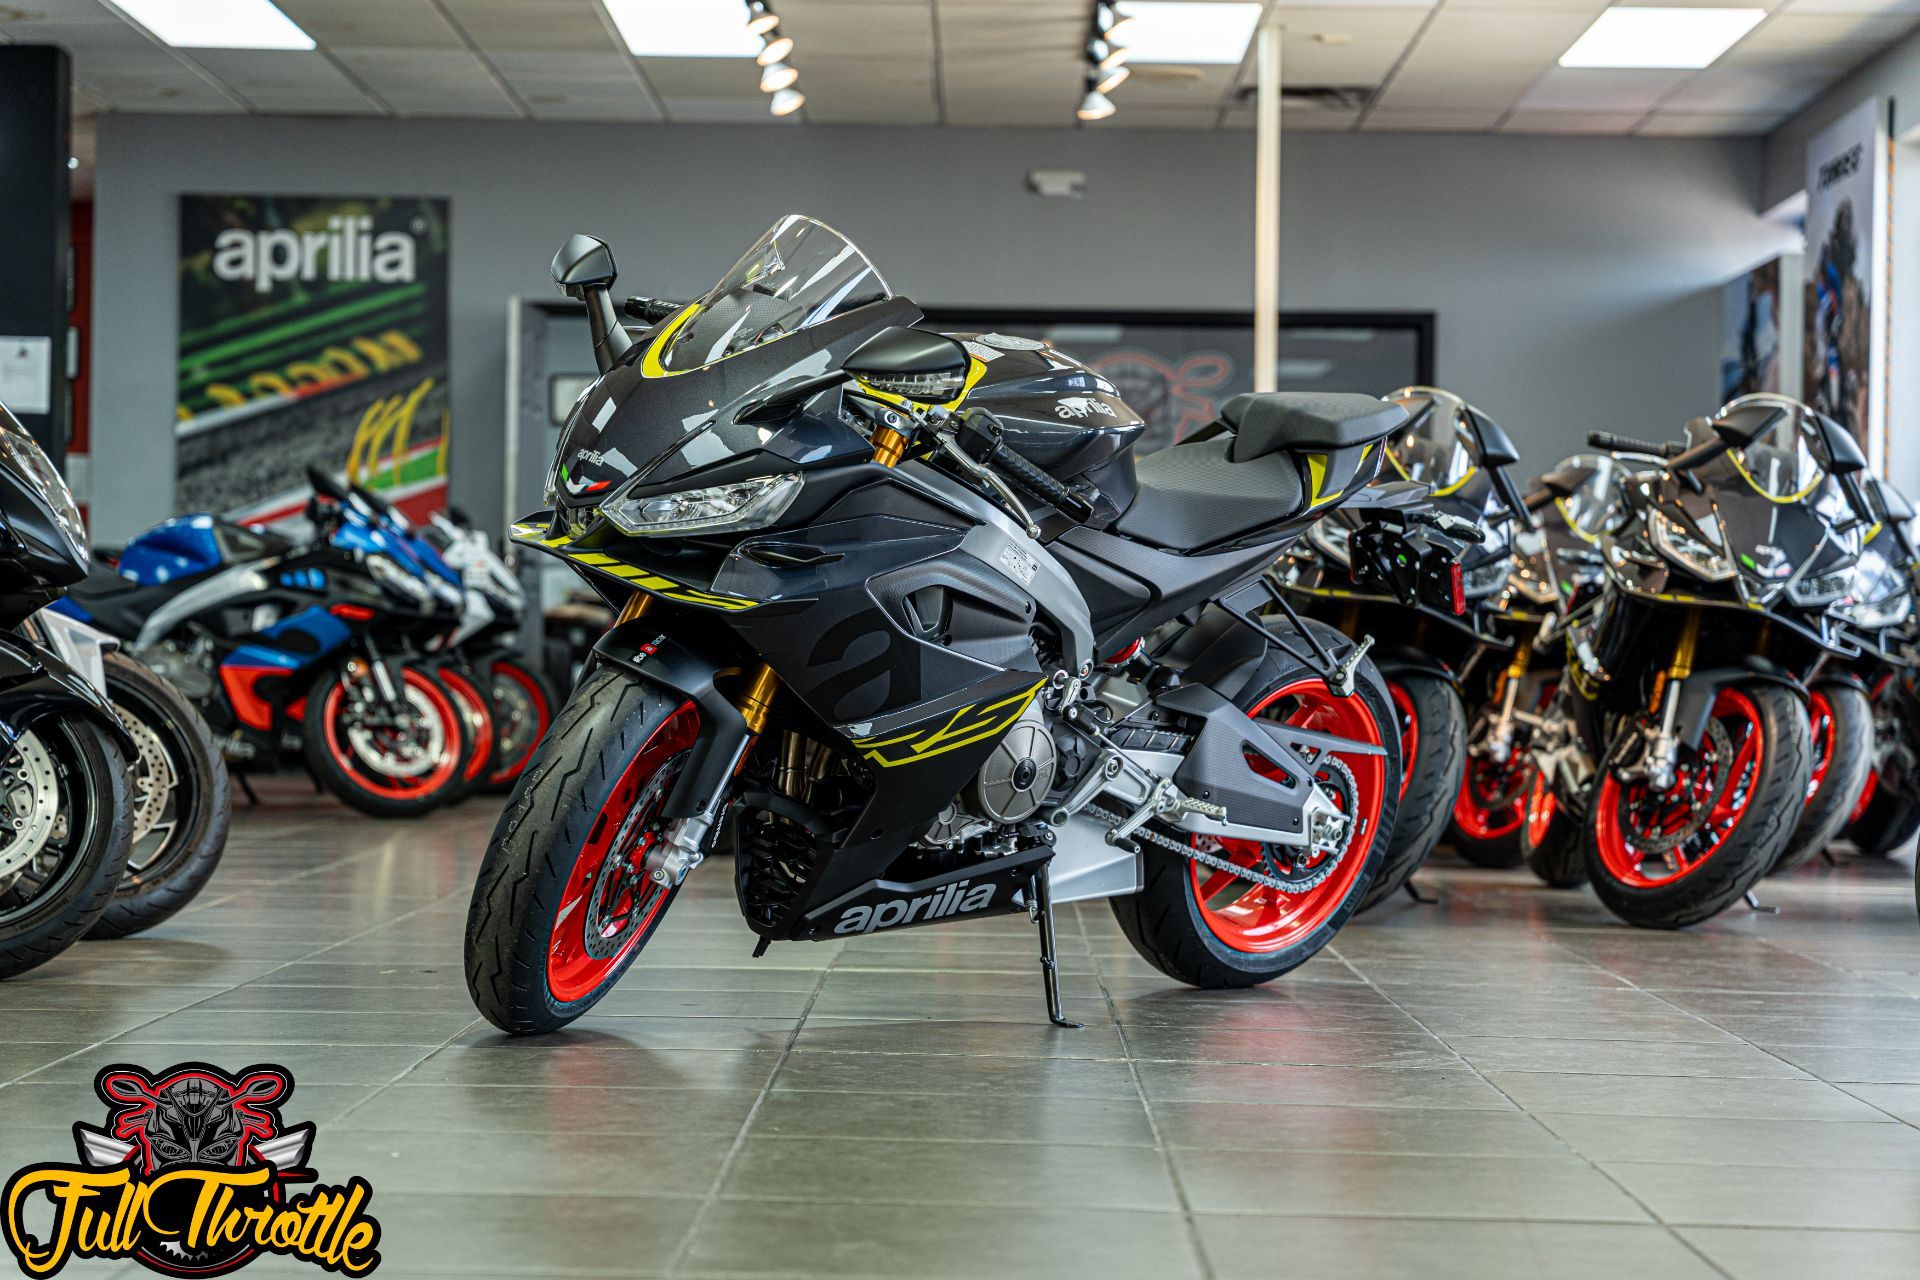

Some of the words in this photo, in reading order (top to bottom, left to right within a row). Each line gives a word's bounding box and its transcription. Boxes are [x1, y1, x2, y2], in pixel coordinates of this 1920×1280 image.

[213, 215, 415, 293] aprilia
[1055, 397, 1117, 418] aprilia
[577, 449, 605, 467] aprilia
[833, 879, 997, 934] aprilia
